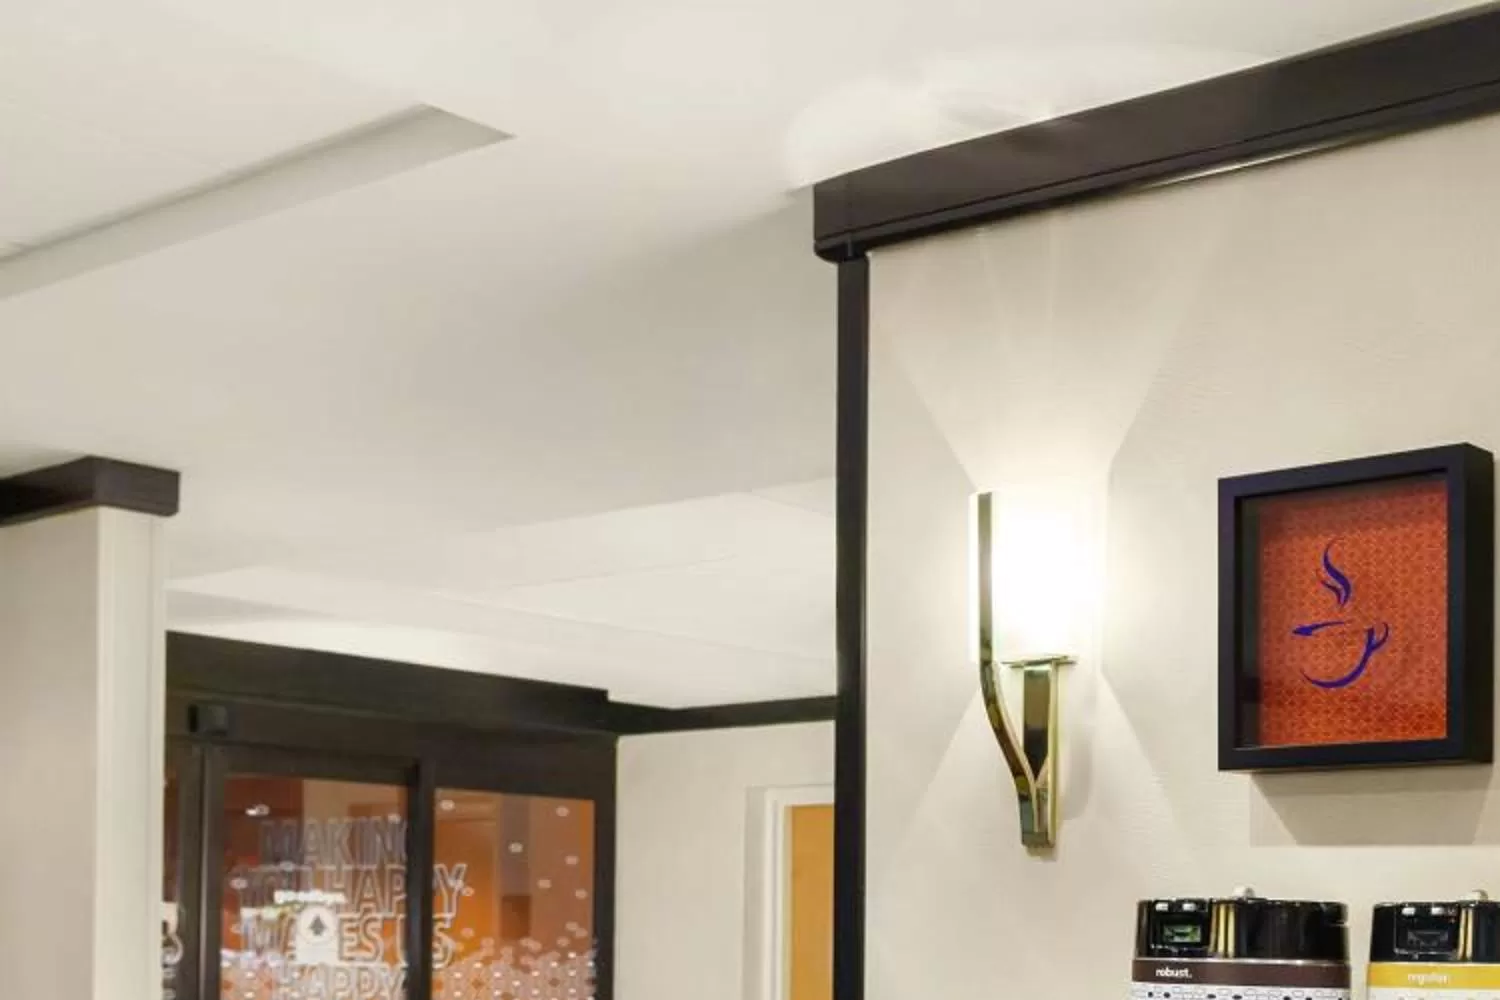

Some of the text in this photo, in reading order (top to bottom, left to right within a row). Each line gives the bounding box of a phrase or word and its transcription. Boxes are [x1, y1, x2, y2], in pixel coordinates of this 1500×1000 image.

[260, 815, 408, 866] MAKIN
[316, 862, 468, 918] HAPY
[1155, 965, 1193, 979] robust.
